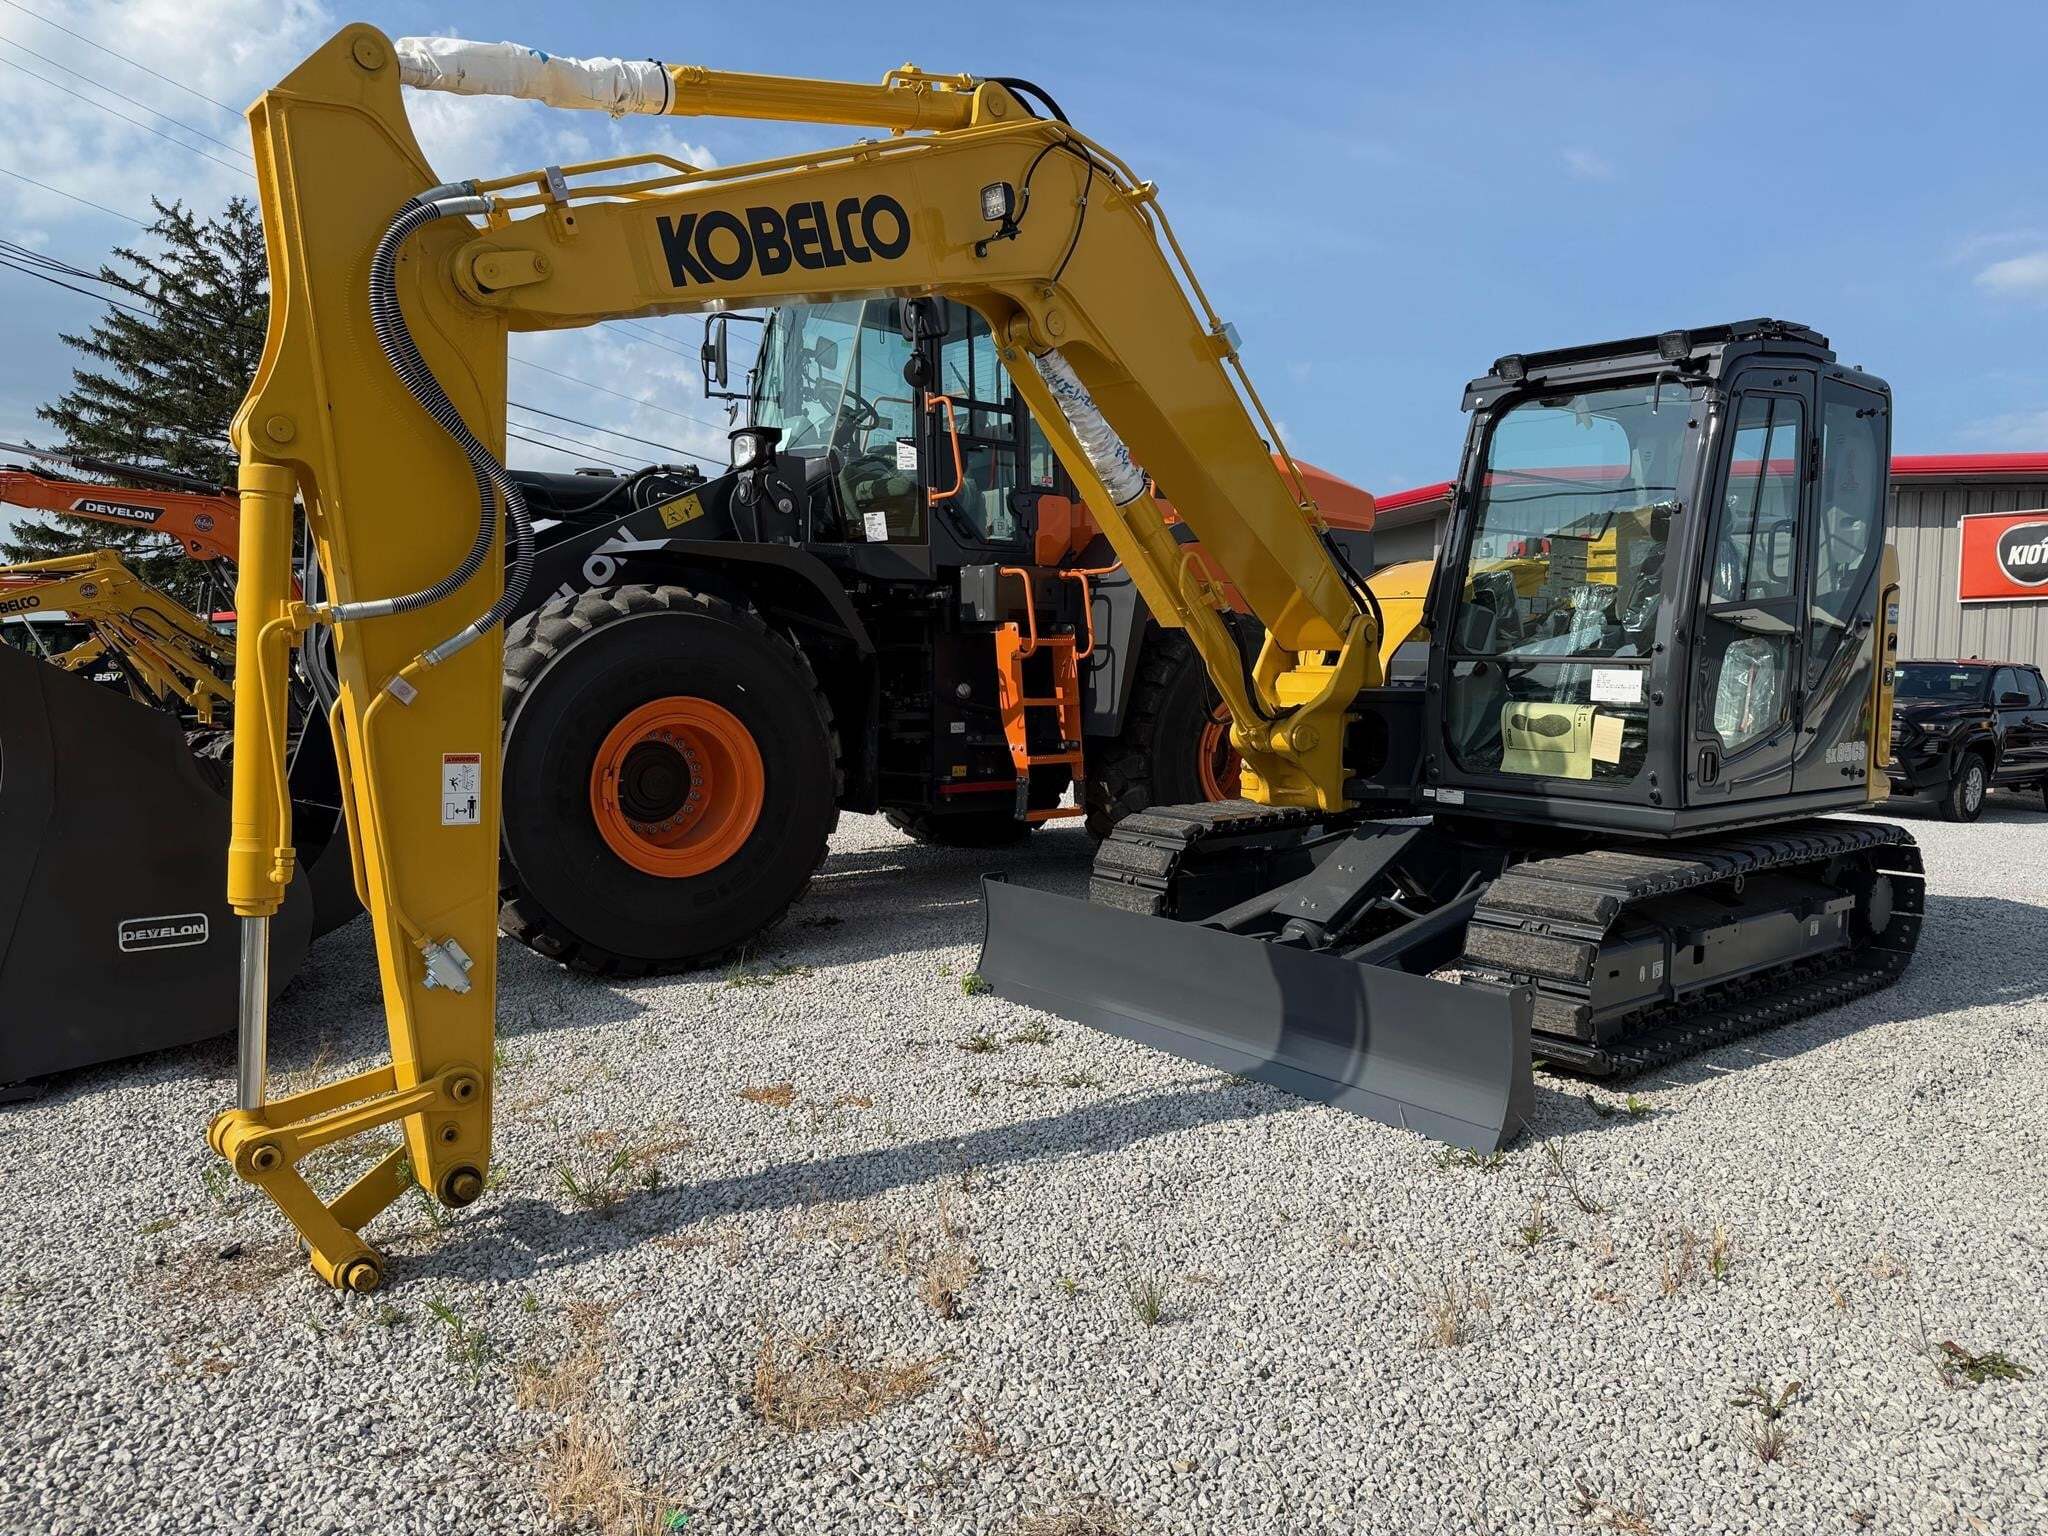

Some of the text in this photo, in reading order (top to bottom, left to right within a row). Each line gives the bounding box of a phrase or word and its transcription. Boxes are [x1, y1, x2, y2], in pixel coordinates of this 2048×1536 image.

[655, 194, 911, 288] KOBELCO
[85, 502, 155, 521] DEVELON
[122, 924, 205, 942] DEVELON
